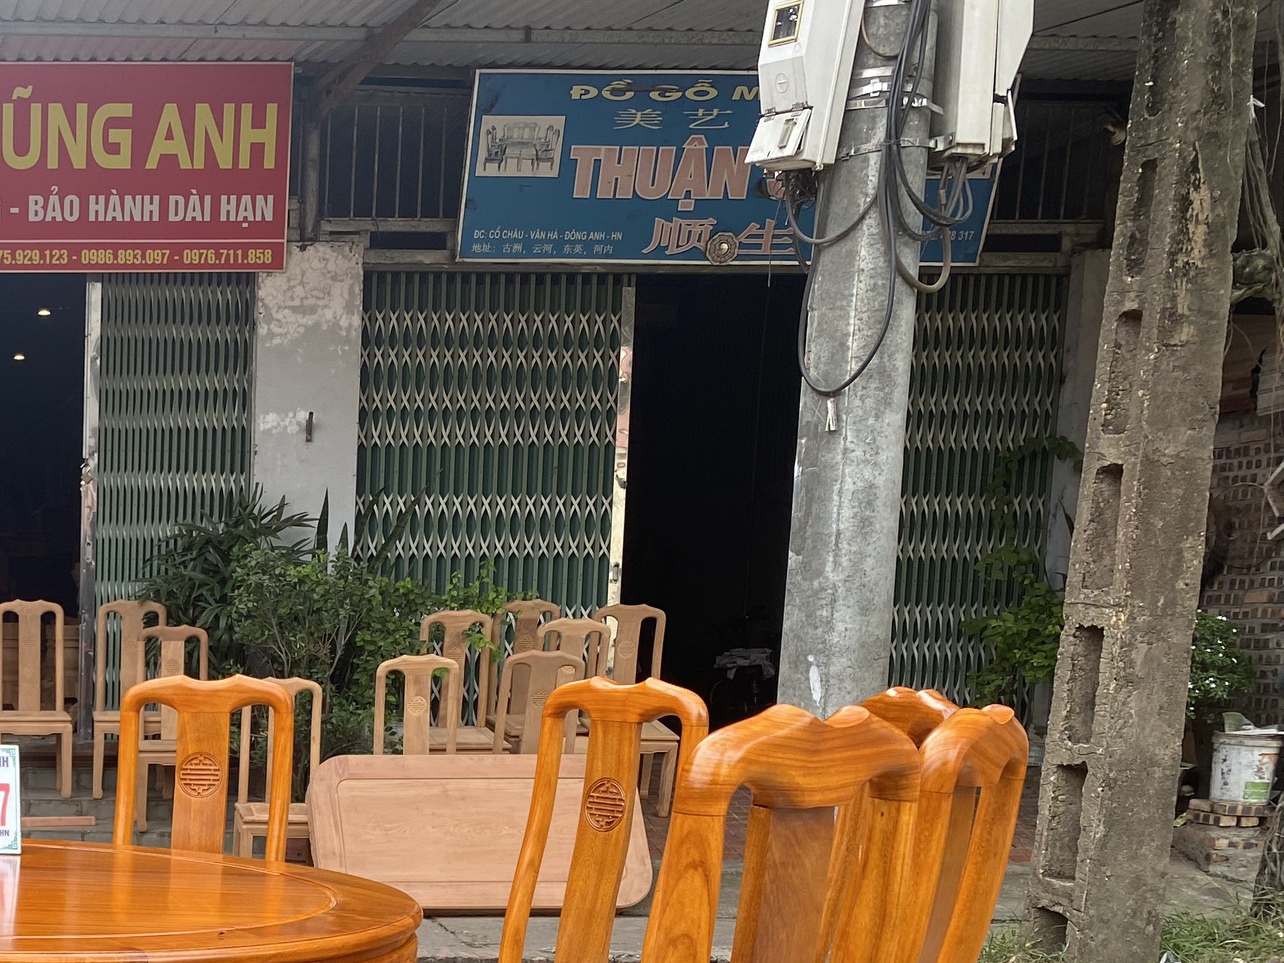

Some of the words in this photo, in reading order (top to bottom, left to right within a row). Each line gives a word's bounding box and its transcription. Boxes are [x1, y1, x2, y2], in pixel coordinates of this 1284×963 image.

[649, 79, 719, 102] GỖ
[144, 102, 278, 170] ANH
[570, 135, 752, 212] THUẬN
[28, 185, 80, 222] BẢO
[88, 188, 160, 222] HÀNH
[168, 188, 211, 222] DÀI
[220, 194, 274, 228] HẠN
[588, 231, 605, 240] ANH
[611, 231, 622, 241] HN
[958, 230, 975, 240] 317
[81, 249, 170, 265] 0986.893.097
[183, 249, 272, 264] 0976.711.858
[0, 829, 10, 837] HN
